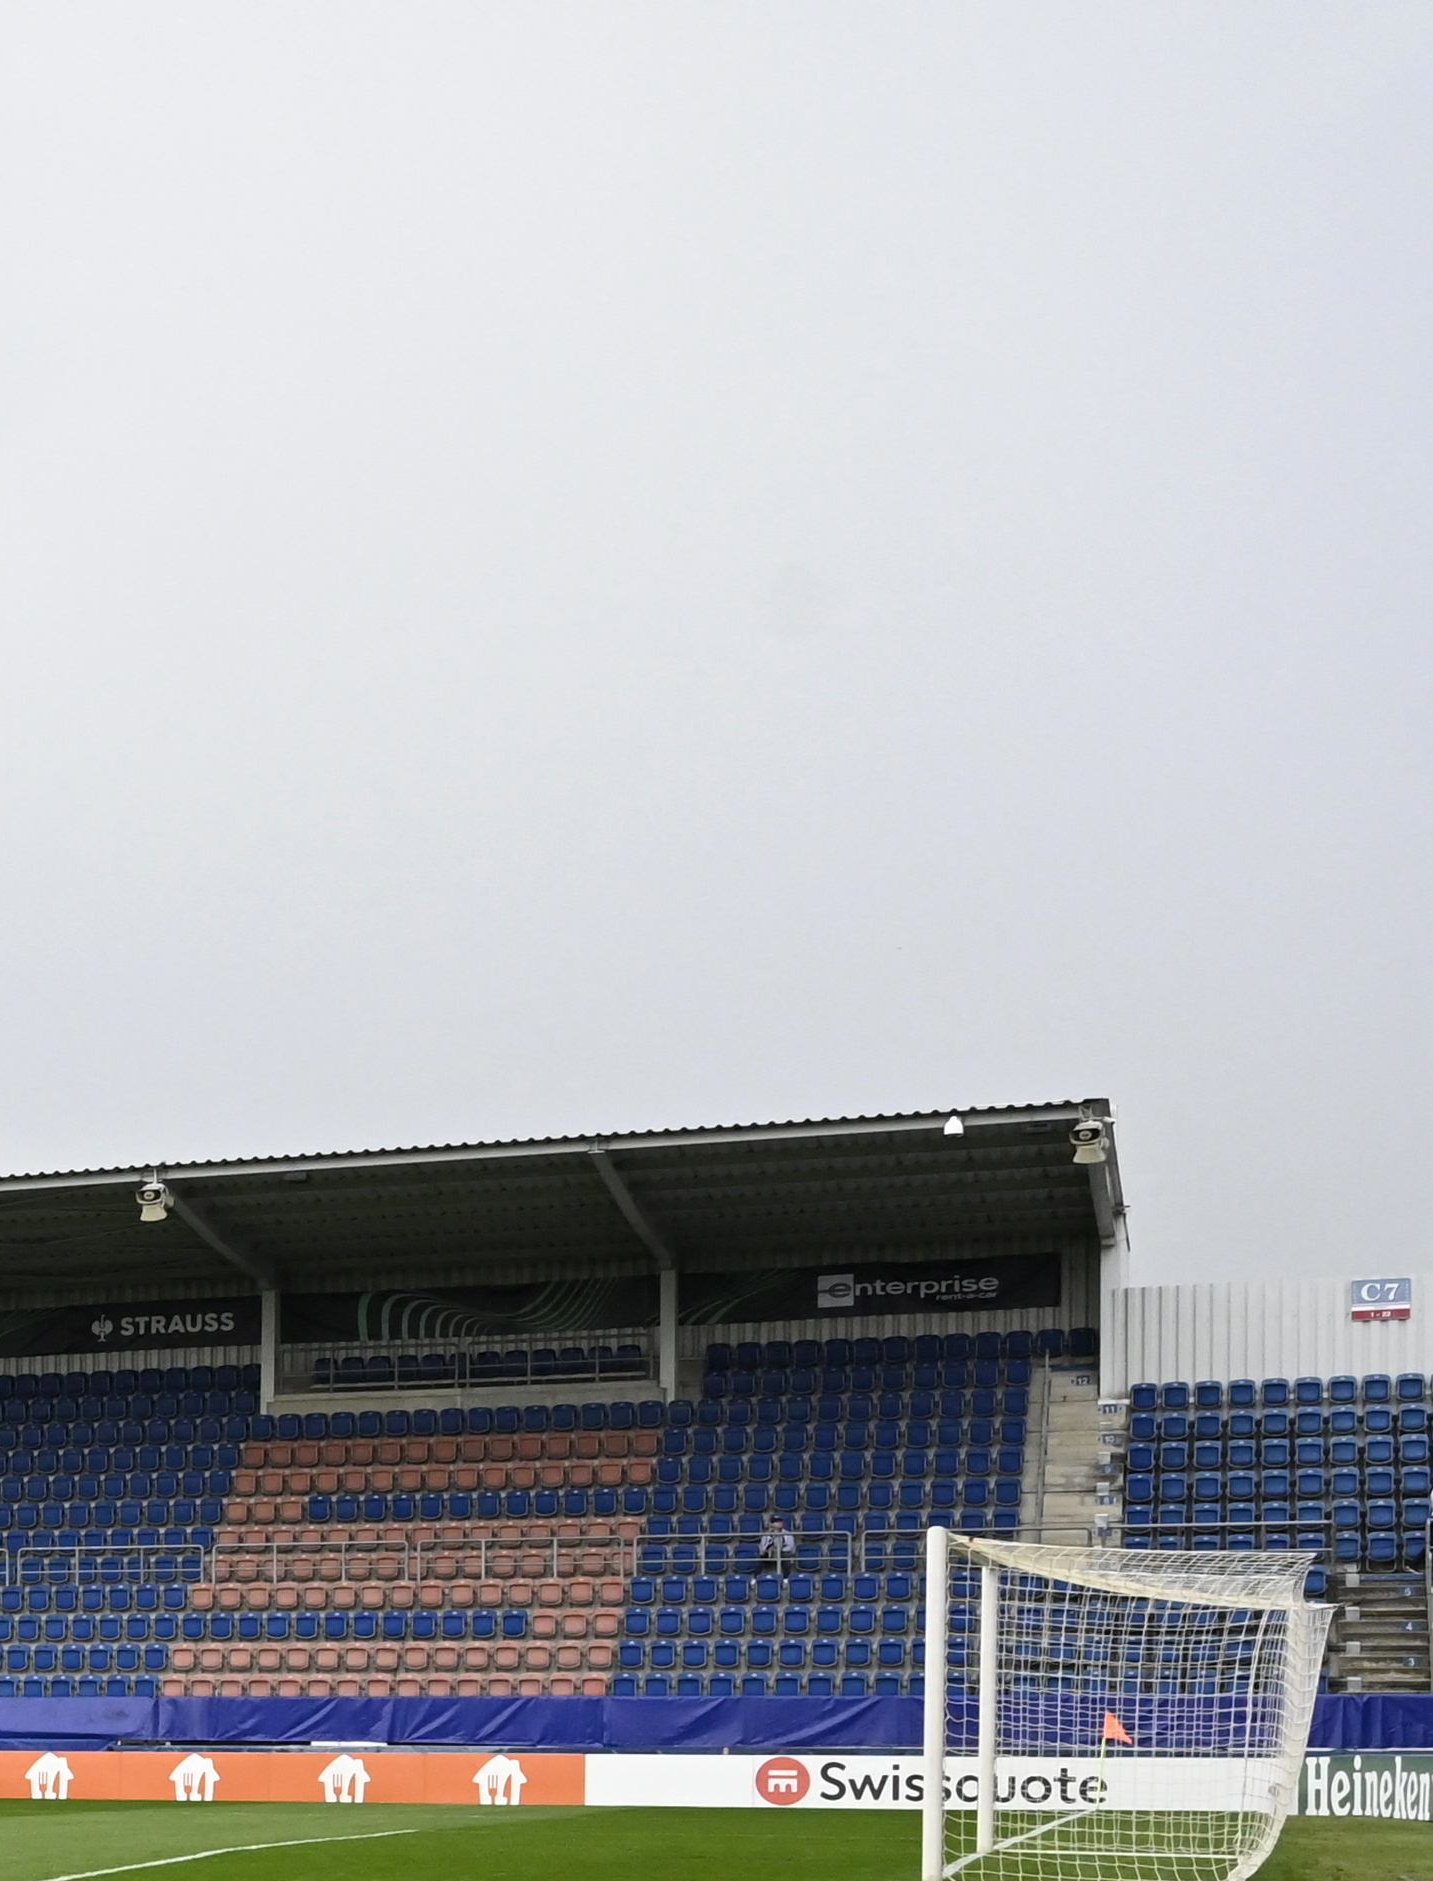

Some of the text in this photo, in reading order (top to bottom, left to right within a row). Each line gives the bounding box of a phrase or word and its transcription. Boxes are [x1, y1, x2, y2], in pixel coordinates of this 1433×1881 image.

[827, 1274, 1000, 1299] enterprise
[1360, 1282, 1400, 1302] C7
[120, 1312, 235, 1337] STRAUSS
[1304, 1754, 1431, 1821] Heineken
